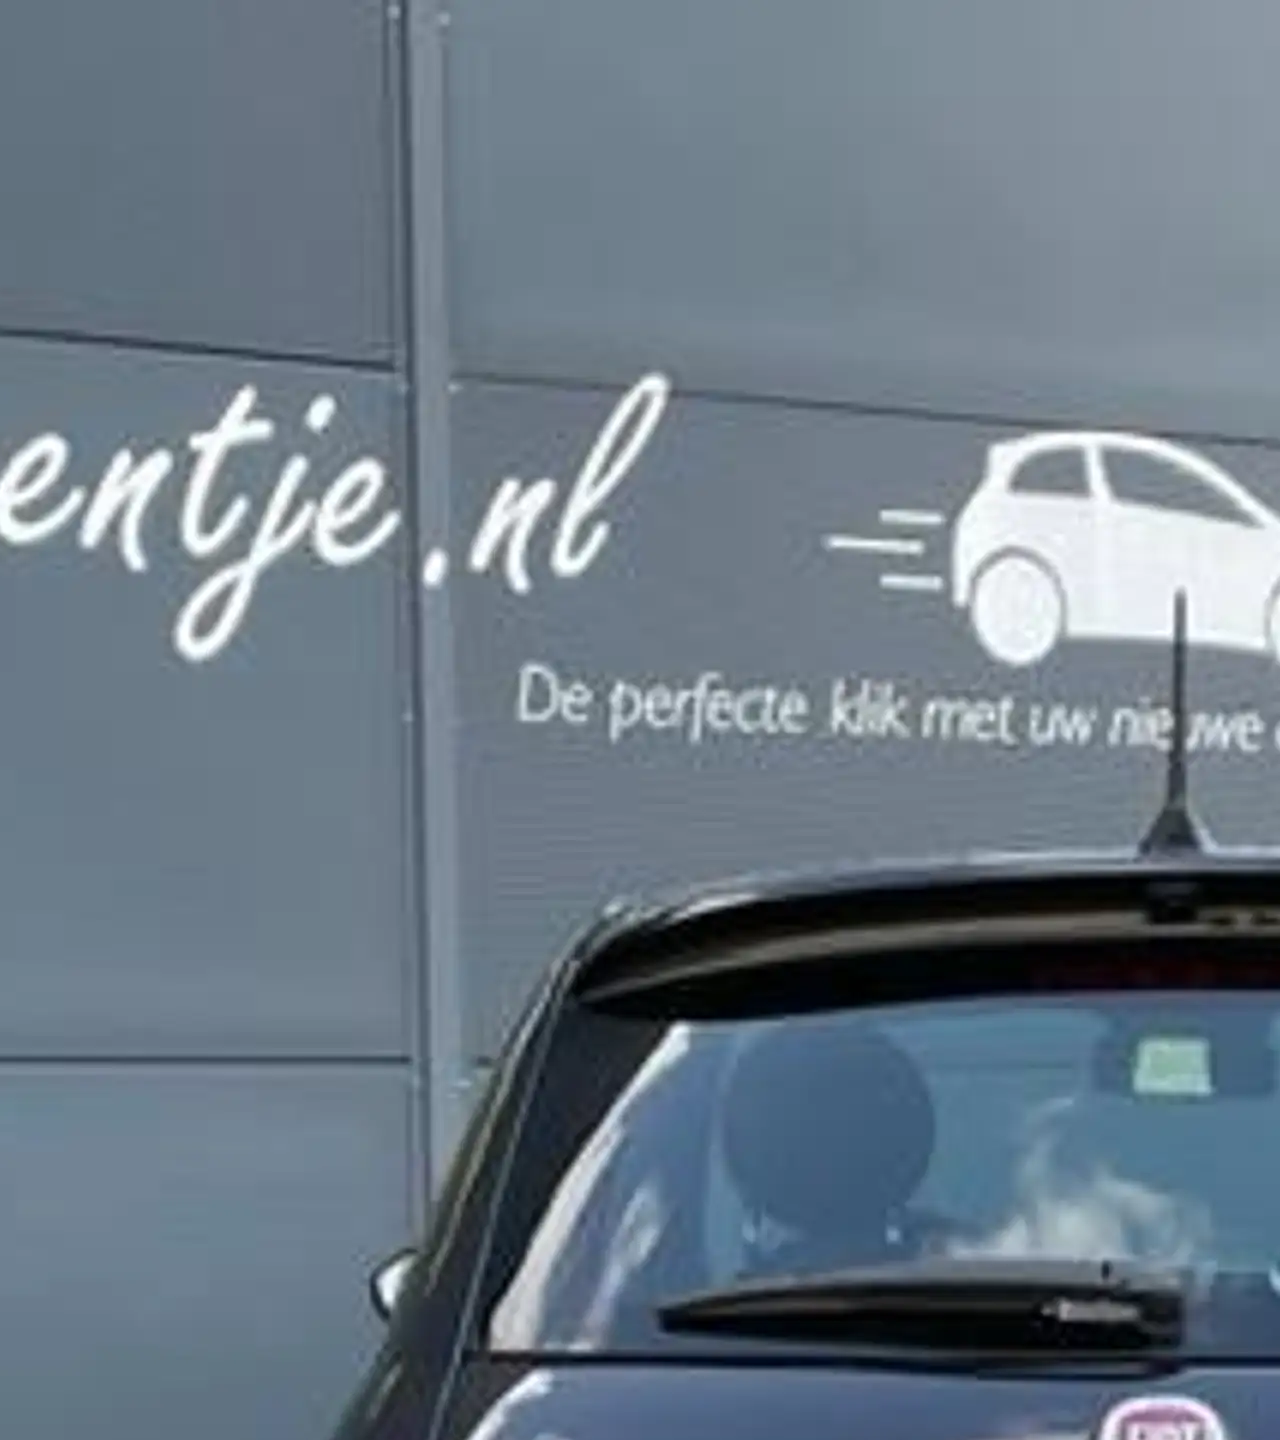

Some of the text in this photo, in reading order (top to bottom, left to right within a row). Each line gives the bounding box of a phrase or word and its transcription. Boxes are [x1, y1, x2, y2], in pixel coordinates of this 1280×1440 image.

[519, 662, 592, 722] De
[609, 670, 810, 744] perfecte
[831, 677, 911, 739] klik
[921, 695, 1018, 745] met
[1029, 703, 1098, 747] uw
